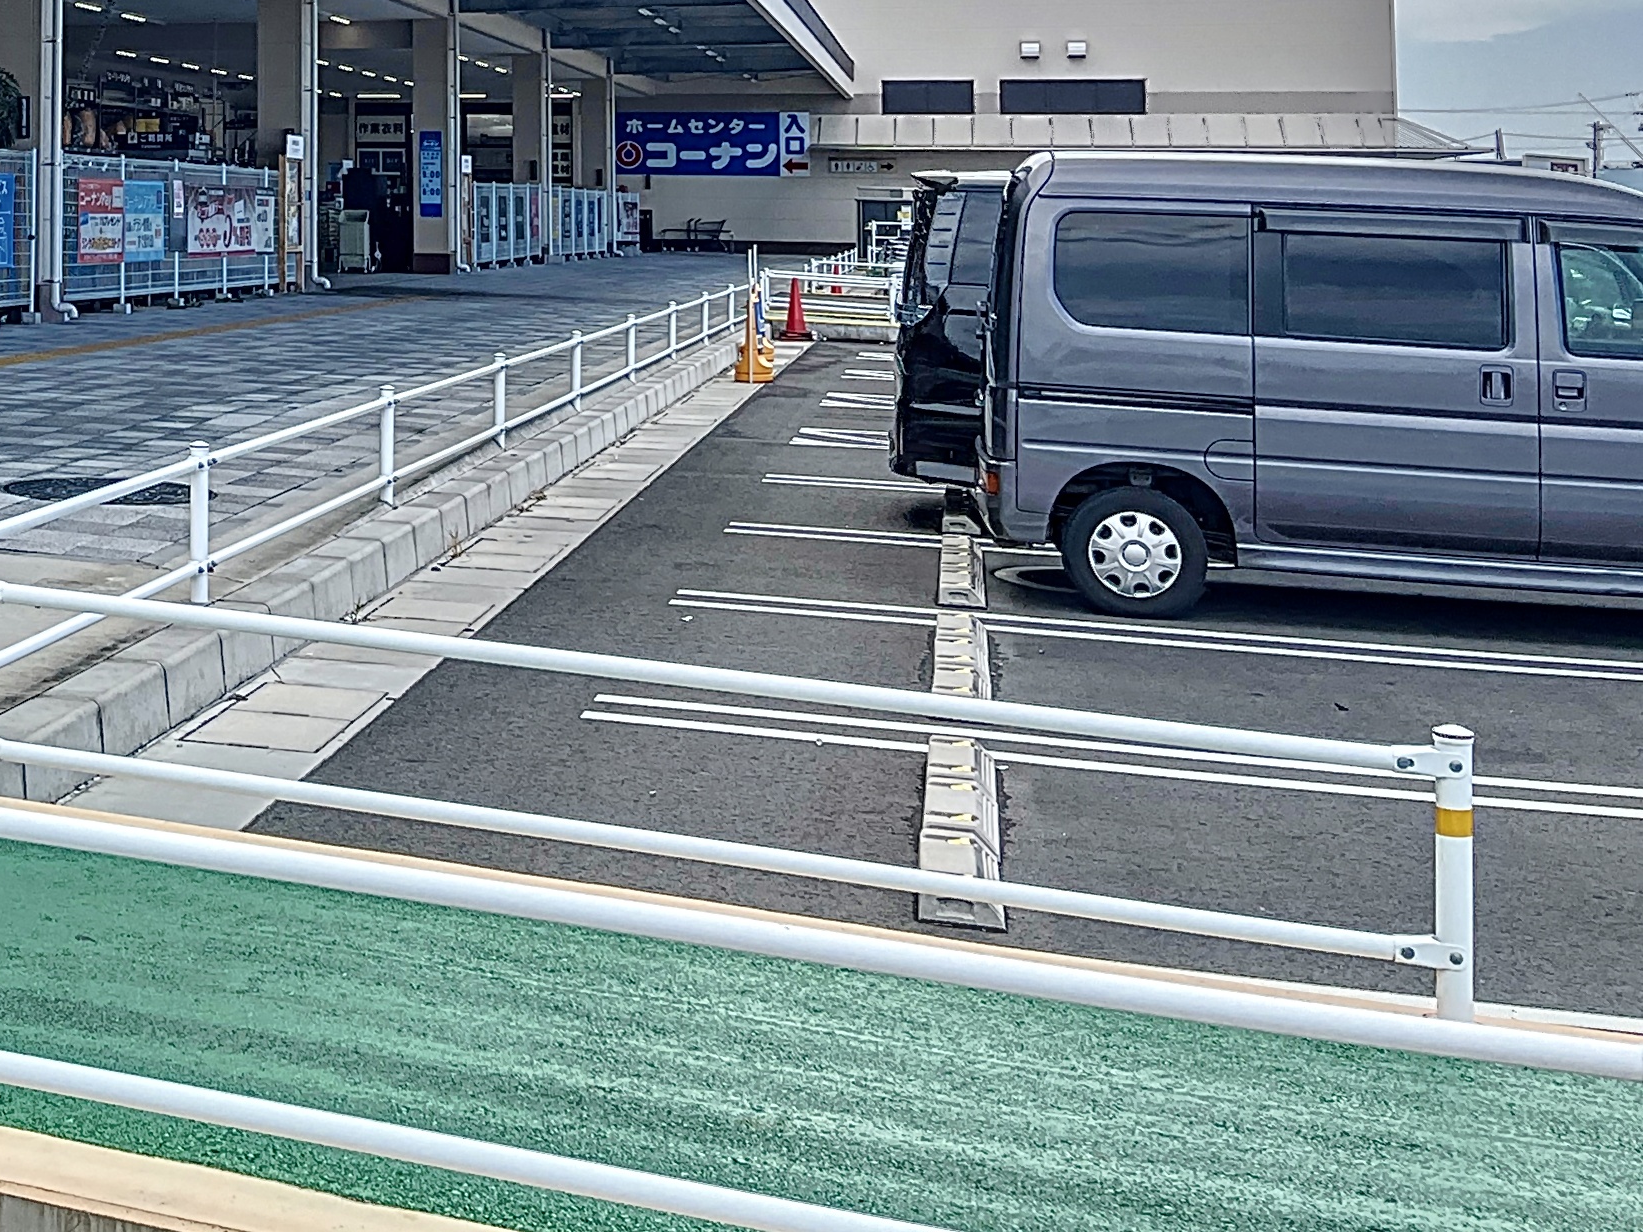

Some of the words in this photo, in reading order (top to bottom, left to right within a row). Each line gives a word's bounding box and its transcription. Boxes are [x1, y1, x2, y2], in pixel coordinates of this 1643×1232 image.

[626, 118, 766, 134] ホームセンター
[784, 113, 806, 156] 入口
[646, 141, 778, 170] コーナン
